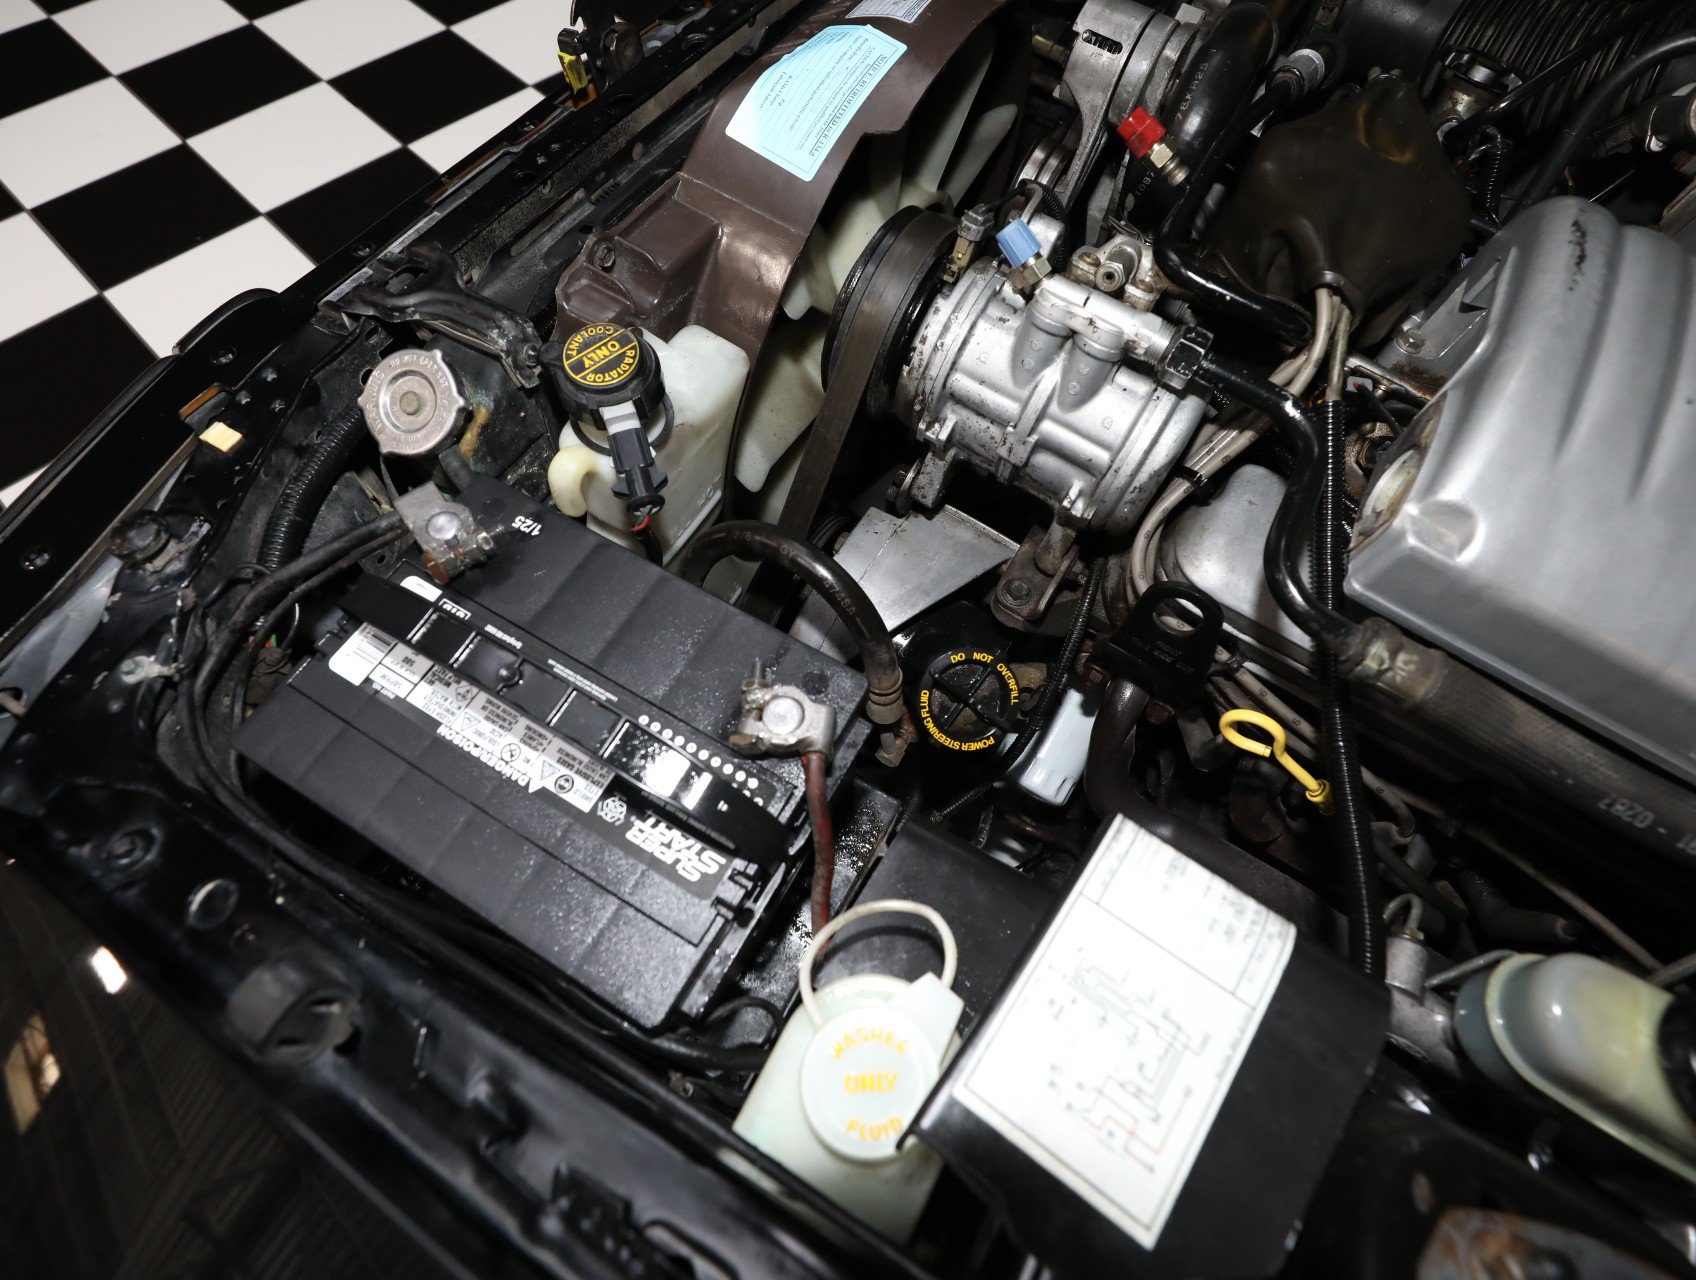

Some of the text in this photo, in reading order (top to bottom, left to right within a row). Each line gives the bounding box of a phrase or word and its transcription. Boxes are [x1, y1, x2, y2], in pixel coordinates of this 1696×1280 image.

[830, 78, 867, 127] RETROFITTED
[566, 326, 614, 356] COOLANT
[582, 340, 620, 369] ONLY
[586, 349, 635, 382] RADIATOR
[511, 515, 542, 536] 1/25
[950, 652, 1019, 705] DO NOT OVERFILL
[920, 690, 995, 751] POWER STEERING FLUID
[436, 722, 530, 787] DANGER/POISON
[623, 825, 705, 883] SUPER
[632, 816, 727, 874] START
[844, 1072, 899, 1095] ONLY
[844, 1115, 904, 1142] FLUID
